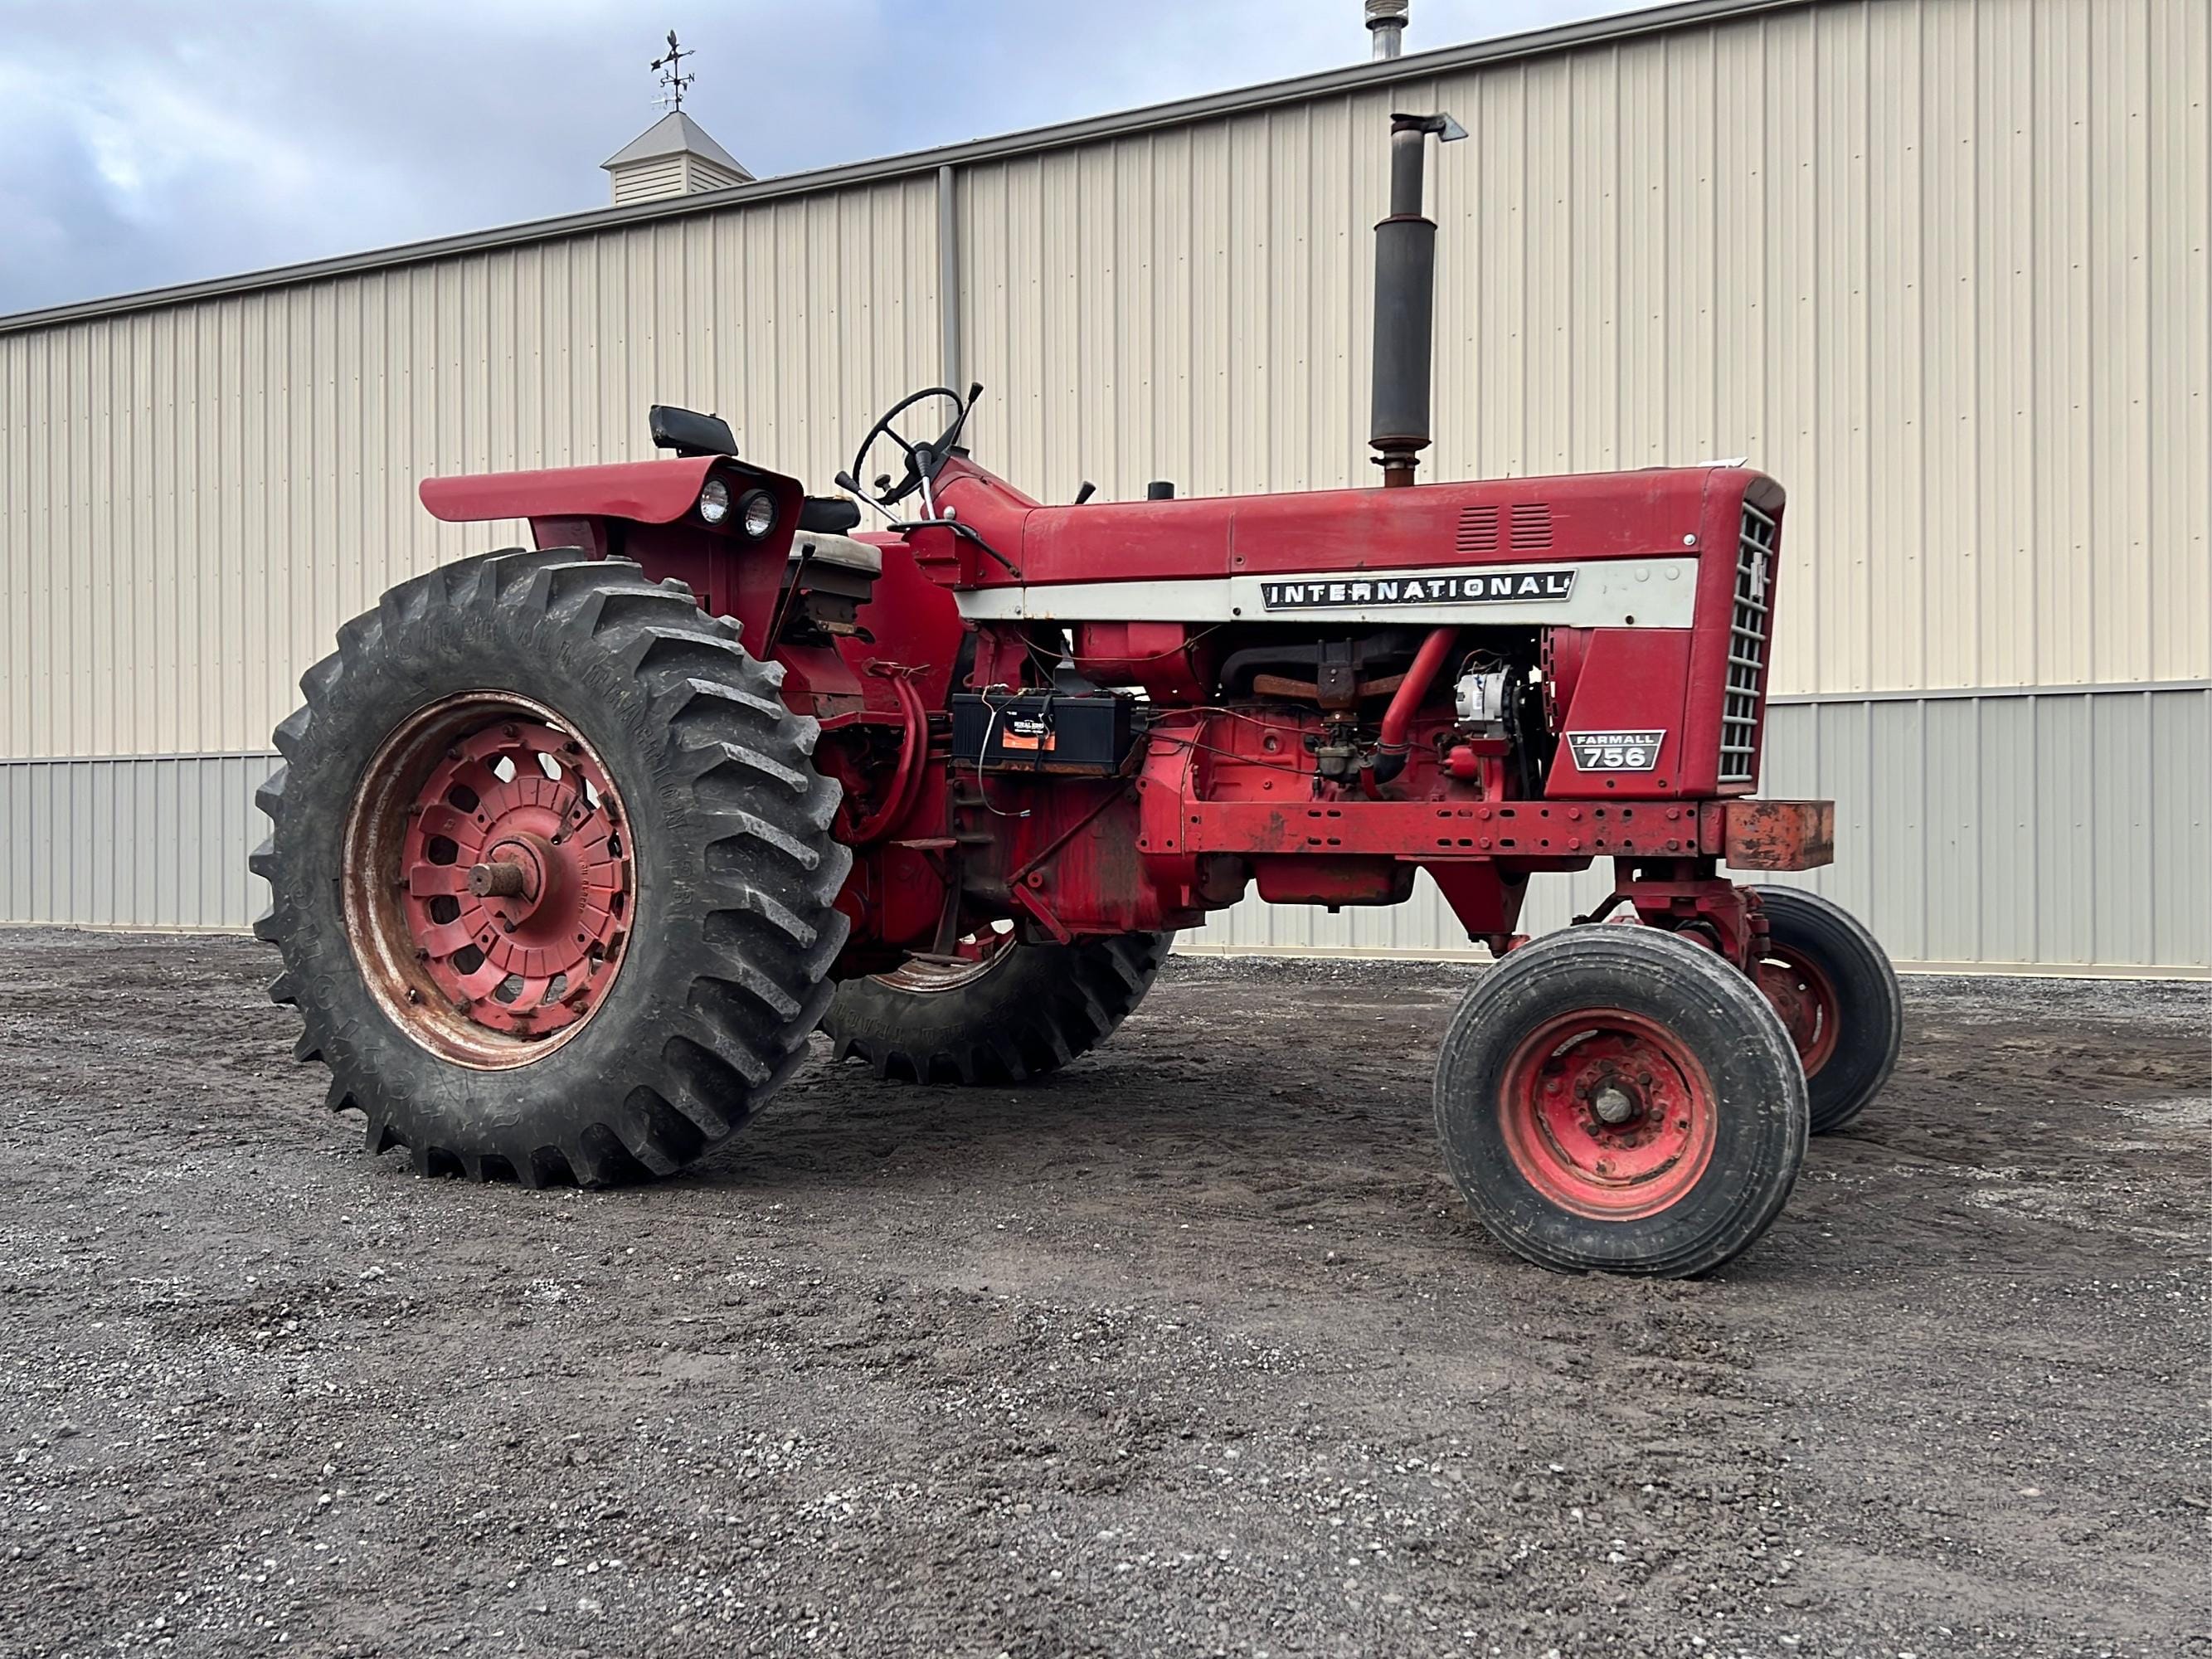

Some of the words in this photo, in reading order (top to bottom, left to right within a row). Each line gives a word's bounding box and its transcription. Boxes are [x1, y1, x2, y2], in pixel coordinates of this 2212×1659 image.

[1270, 575, 1569, 603] INTERNATIONAL
[1577, 735, 1655, 745] FARMALL
[1583, 747, 1646, 767] 756
[290, 876, 523, 1130] Frestone
